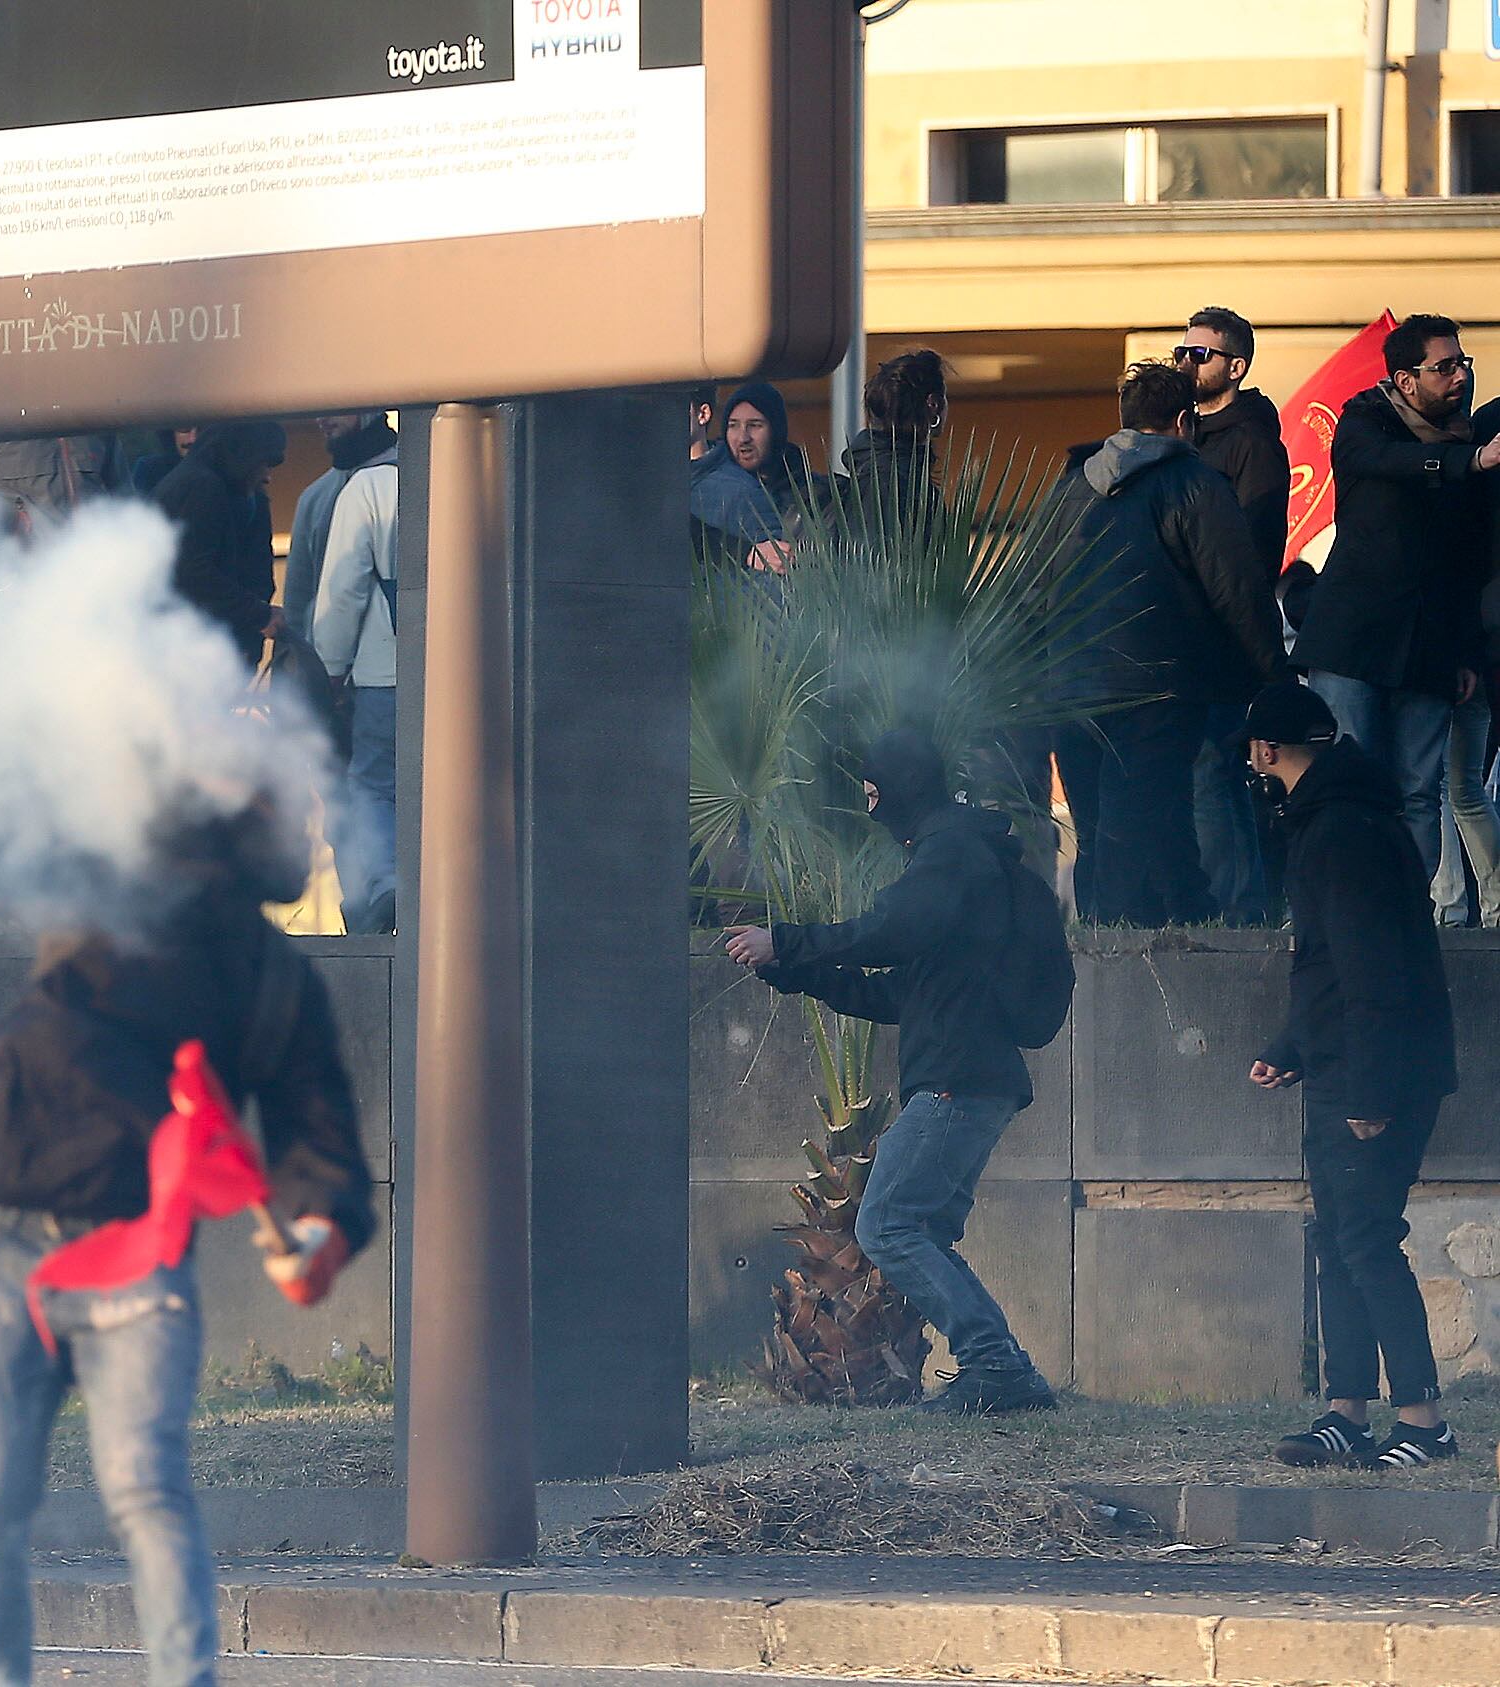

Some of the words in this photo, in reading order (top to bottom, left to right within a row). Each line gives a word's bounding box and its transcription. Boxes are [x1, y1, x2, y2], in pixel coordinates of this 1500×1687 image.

[387, 34, 485, 84] toyota.it
[532, 33, 622, 59] HYBRID
[3, 160, 34, 175] 27.950
[115, 149, 165, 165] Contributo
[167, 143, 219, 160] Pneumatici
[221, 140, 245, 154] Fuori
[109, 174, 140, 188] presso
[148, 164, 211, 182] concessionari
[213, 162, 231, 175] che
[232, 160, 284, 173] aderiscono
[30, 195, 65, 210] risultati
[67, 194, 82, 207] dei
[84, 193, 102, 206] test
[105, 190, 148, 205] effettuati
[161, 184, 228, 201] collaborazione
[230, 184, 248, 194] con
[65, 214, 108, 229] emissioni
[130, 210, 146, 223] 118
[72, 313, 106, 350] DI
[122, 304, 242, 346] NAPOLI
